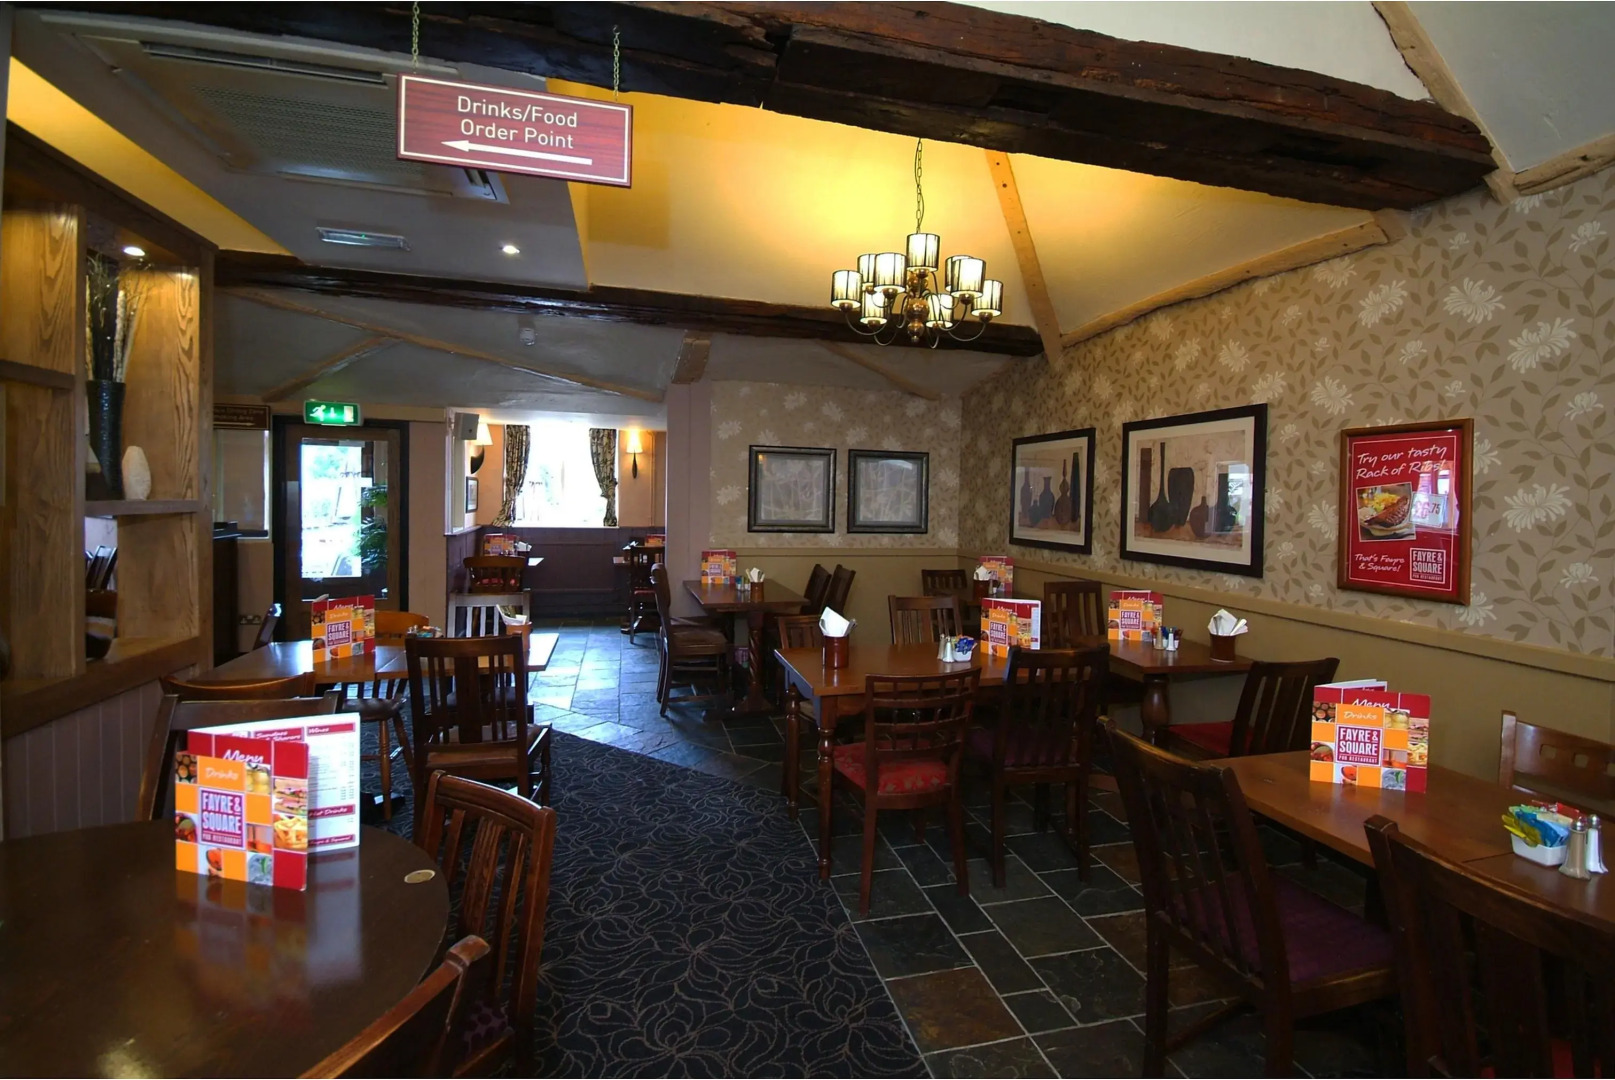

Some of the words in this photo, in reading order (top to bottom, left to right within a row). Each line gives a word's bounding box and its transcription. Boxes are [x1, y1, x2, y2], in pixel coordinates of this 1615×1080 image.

[457, 95, 578, 128] Drinks/Food
[460, 118, 518, 141] Order
[524, 127, 574, 149] Point
[1357, 452, 1378, 467] Try
[1381, 451, 1403, 462] our
[1407, 444, 1447, 459] tasty
[1356, 466, 1389, 480] Rack
[1391, 462, 1406, 476] of
[1408, 459, 1446, 475] Ribs!
[1354, 553, 1378, 563] That's
[1380, 553, 1405, 566] Fayre
[1412, 550, 1437, 563] FAYRE
[1437, 552, 1442, 563] &
[1358, 562, 1366, 570] &
[1366, 562, 1402, 573] Square!
[1412, 561, 1442, 575] SQUARE
[1343, 711, 1378, 720] Drinks
[308, 726, 330, 734] Wines
[1340, 728, 1371, 743] FAYRE
[1371, 730, 1379, 743] &
[1339, 740, 1378, 756] SQUARE
[222, 749, 265, 764] Menu
[205, 767, 239, 781] Drinks
[202, 793, 234, 814] FAYRE
[233, 796, 241, 816] &
[324, 807, 348, 815] Drinks
[202, 811, 242, 834] SQUARE
[202, 834, 212, 842] PUB
